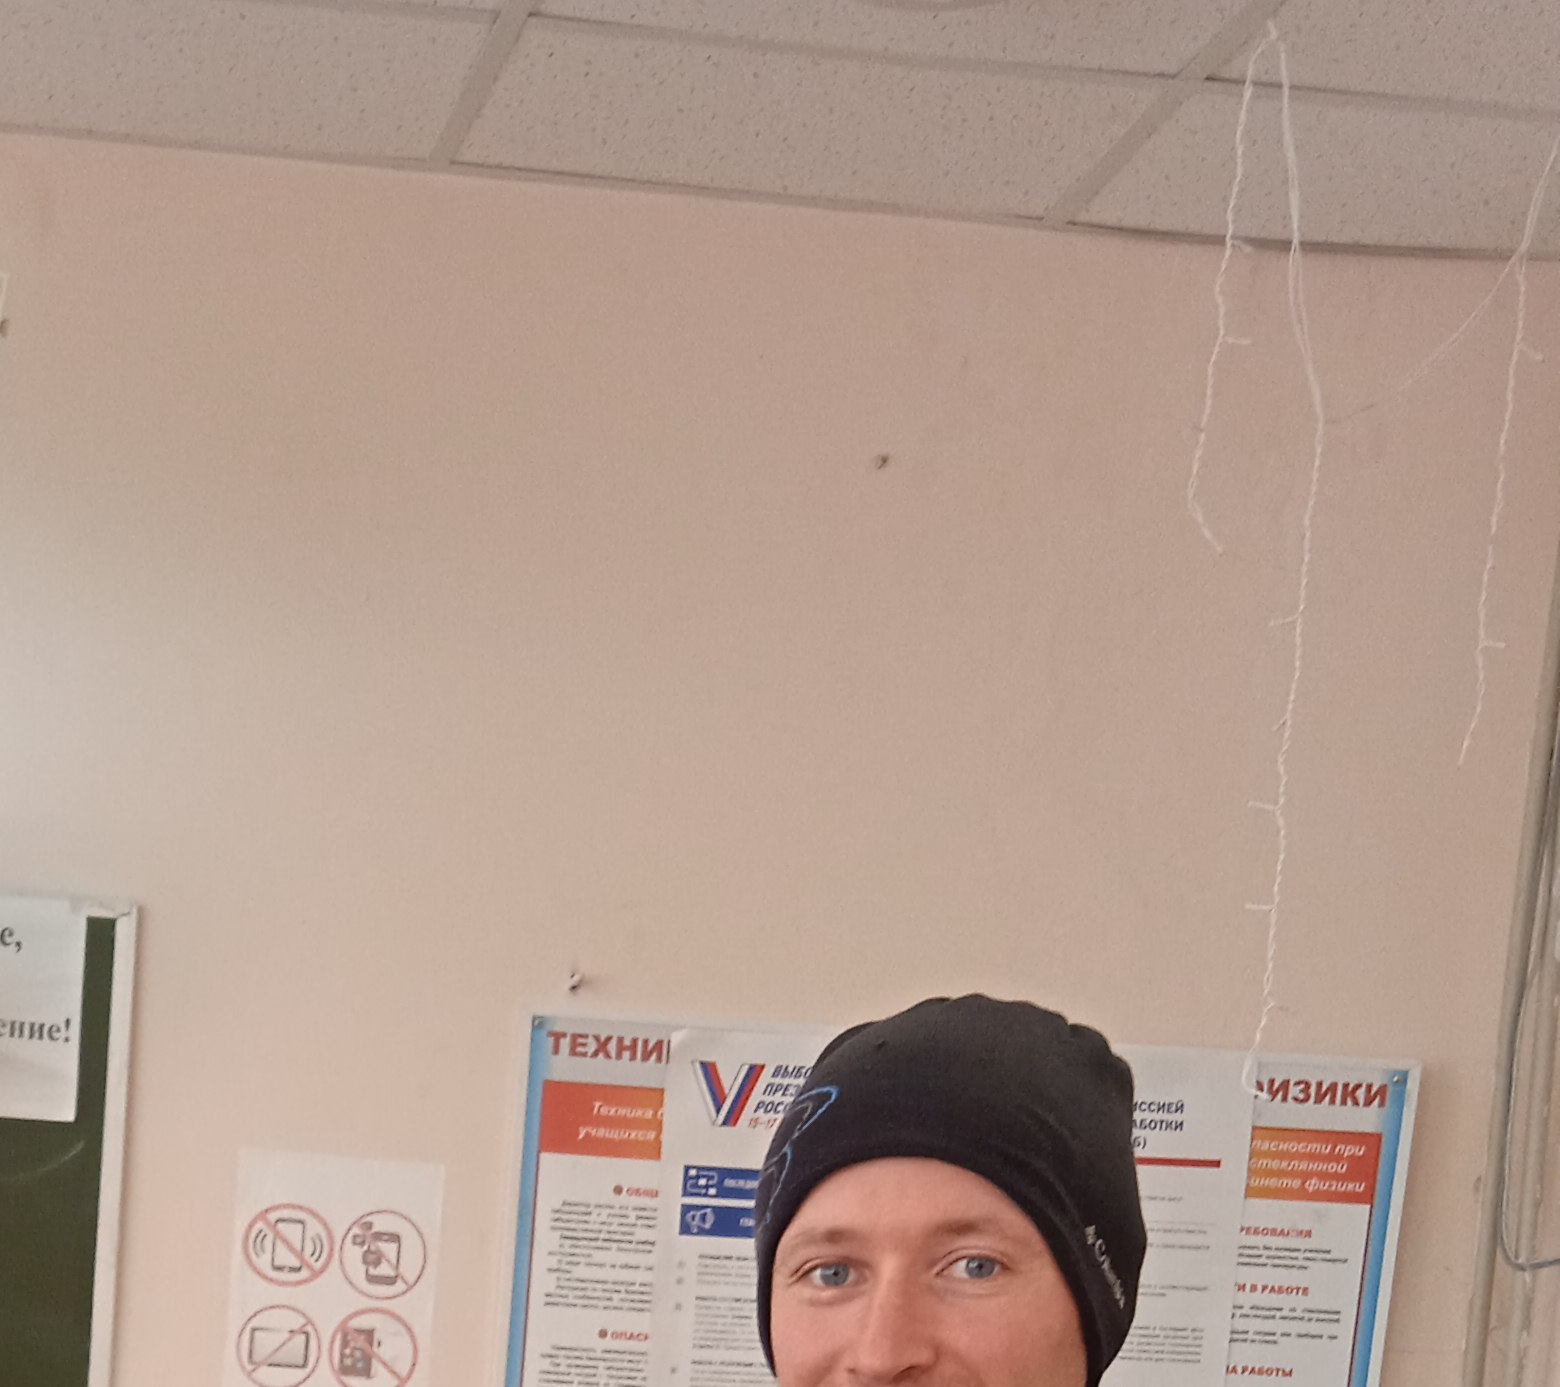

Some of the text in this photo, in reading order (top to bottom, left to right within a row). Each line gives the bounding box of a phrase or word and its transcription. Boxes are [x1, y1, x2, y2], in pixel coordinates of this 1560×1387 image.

[546, 1030, 671, 1065] ТЕХНИ
[593, 1101, 653, 1120] Техника
[577, 1126, 657, 1141] учащихся
[1334, 1144, 1366, 1158] при
[1250, 1157, 1348, 1174] стеклянной
[1304, 1177, 1366, 1193] физики
[1261, 1284, 1309, 1297] РАБОТЕ
[1241, 1365, 1294, 1378] РАБОТЫ
